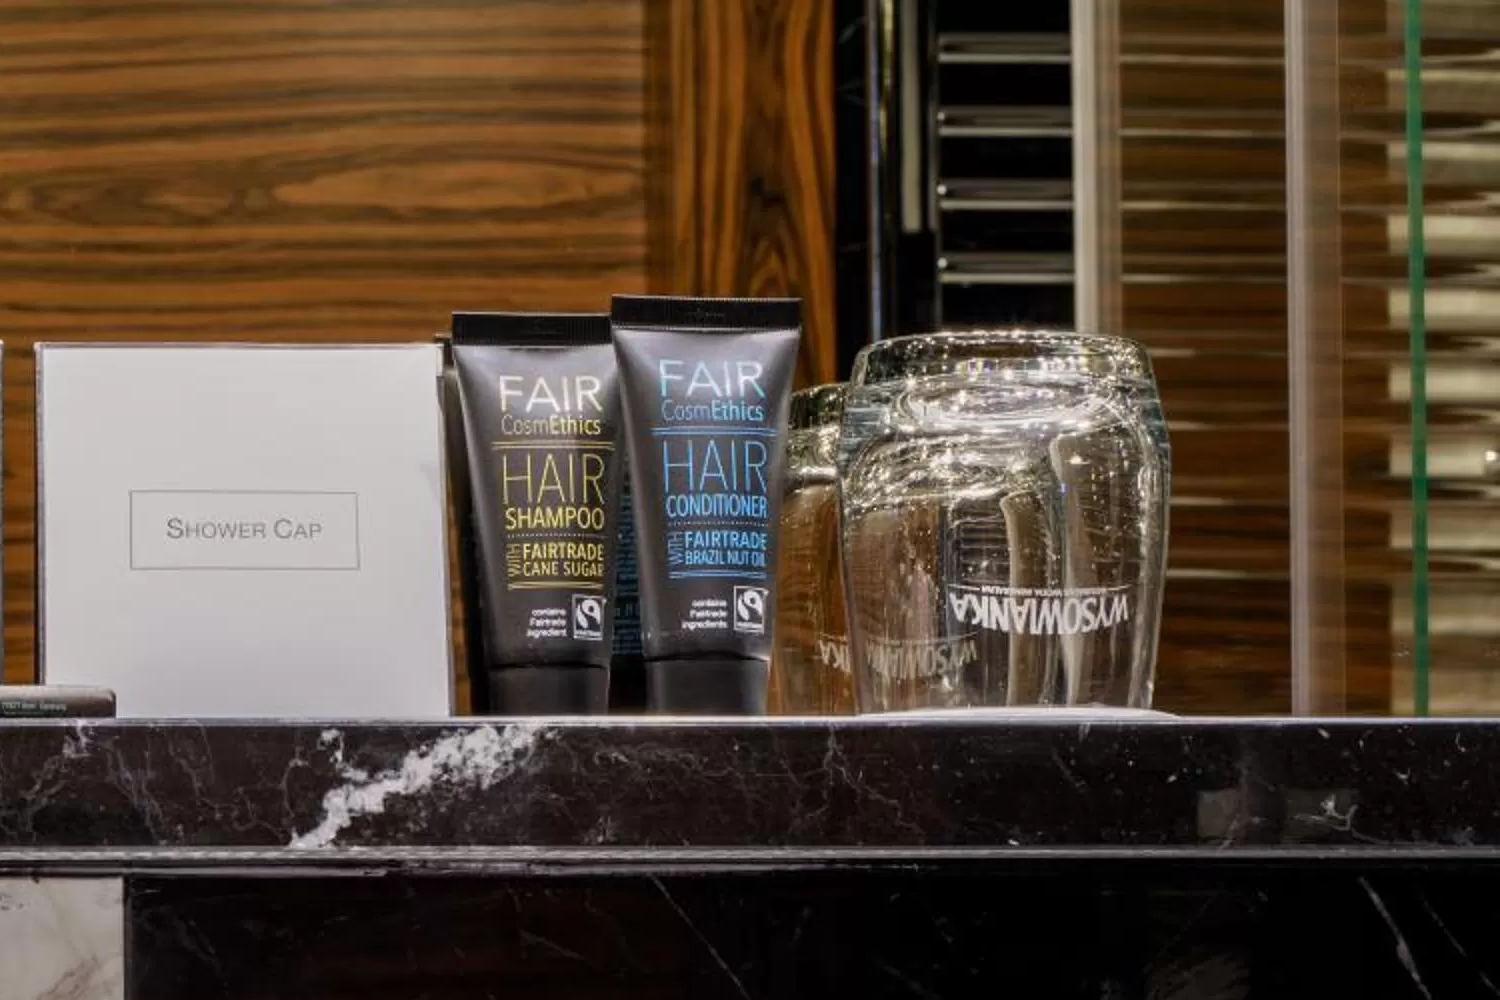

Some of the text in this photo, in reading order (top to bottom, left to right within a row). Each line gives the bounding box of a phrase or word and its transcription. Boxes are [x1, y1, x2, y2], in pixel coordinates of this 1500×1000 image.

[659, 359, 766, 398] FAIR
[500, 375, 603, 413] FAIR
[661, 399, 765, 422] CosmEthics
[501, 413, 601, 436] CosmEthics
[663, 439, 768, 493] HAIR
[503, 453, 606, 505] HAIR
[666, 493, 768, 518] CONDITIONER
[505, 507, 605, 531] SHAMPOO
[522, 542, 605, 561] FAIRTRADE
[684, 530, 768, 550] FAIRTRADE
[522, 561, 605, 577] CANE SUGAR
[684, 549, 768, 568] BRAZIL NUT OIL
[949, 592, 1128, 635] WYSOWIANKA
